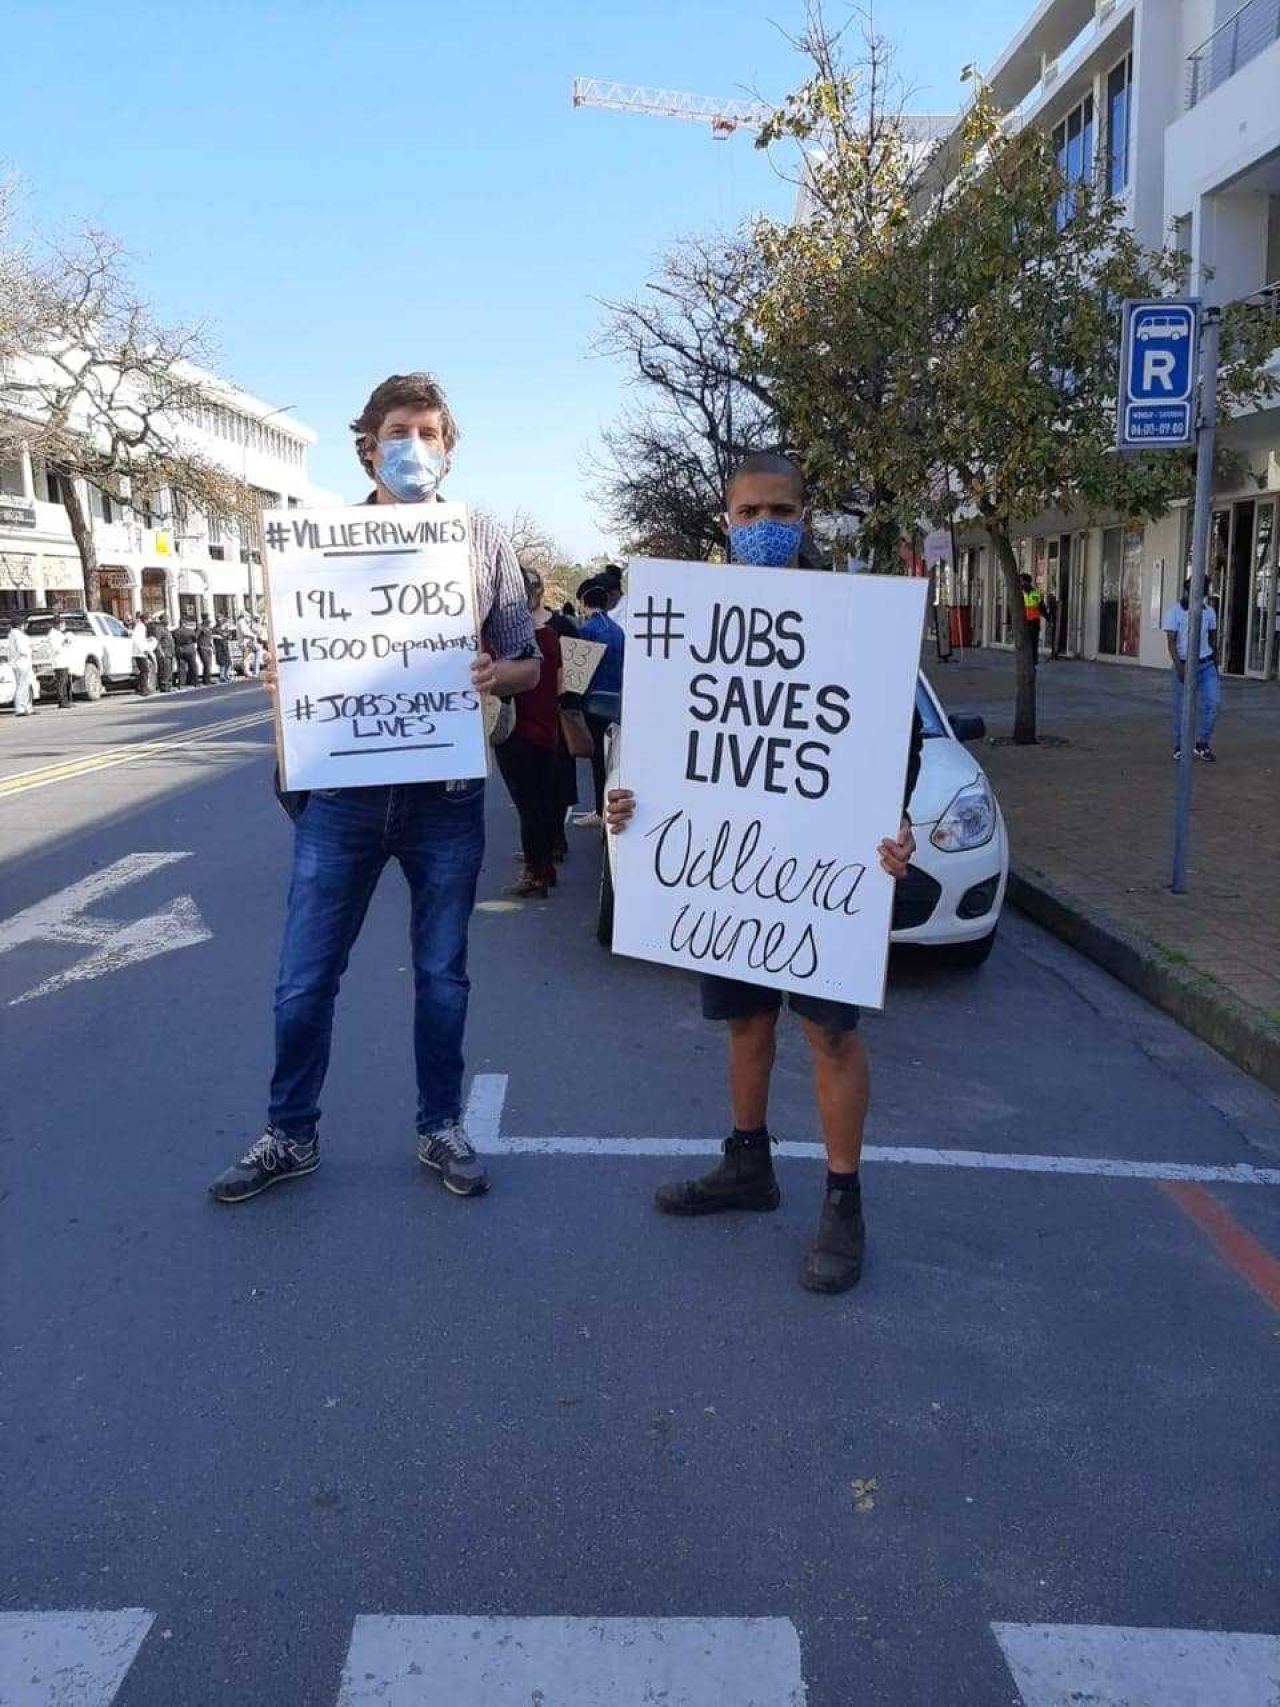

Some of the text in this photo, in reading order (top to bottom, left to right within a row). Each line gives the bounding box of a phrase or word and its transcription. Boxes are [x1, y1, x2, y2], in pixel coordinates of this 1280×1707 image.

[1142, 350, 1176, 391] R
[296, 581, 465, 620] 194 JOBS
[353, 714, 437, 738] LIVES
[688, 673, 851, 734] SAVES
[685, 730, 831, 800] LIVES
[645, 809, 867, 916] Villiera
